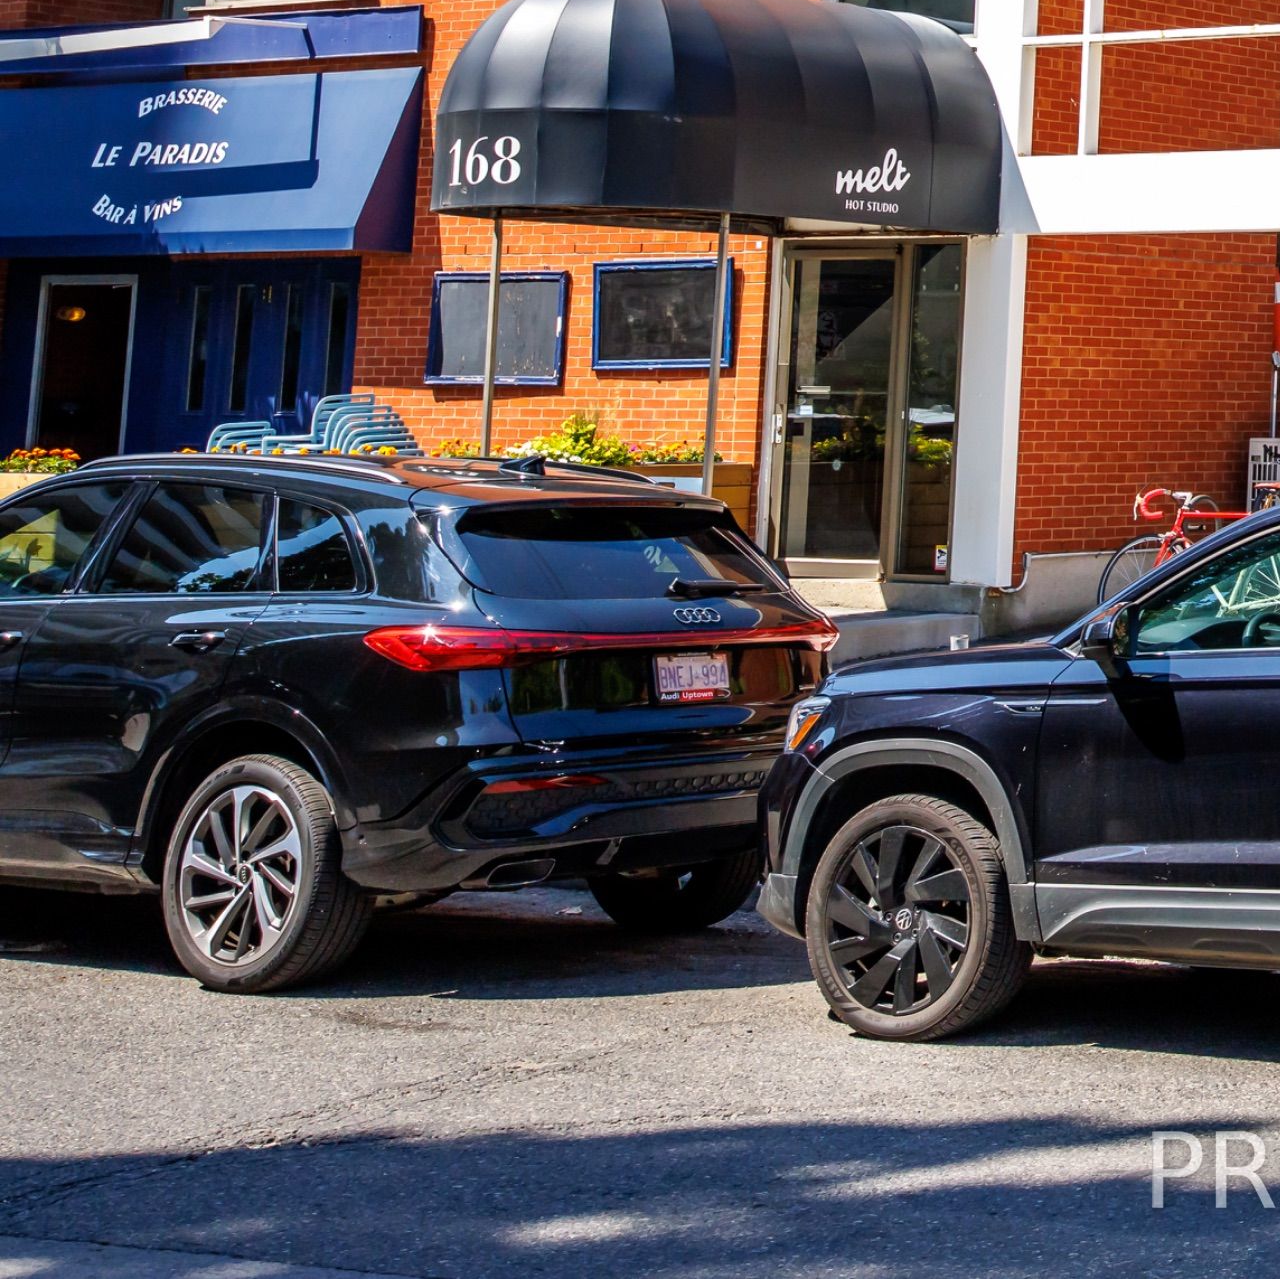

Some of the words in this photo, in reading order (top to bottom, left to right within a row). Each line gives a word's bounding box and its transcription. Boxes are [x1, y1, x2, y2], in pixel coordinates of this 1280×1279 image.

[138, 88, 228, 118] BRASSERIE
[449, 135, 521, 187] 168
[836, 148, 911, 194] melt
[845, 200, 864, 210] HOT
[867, 201, 899, 213] STUDIO
[661, 692, 679, 700] Audi
[682, 691, 713, 701] Uptown
